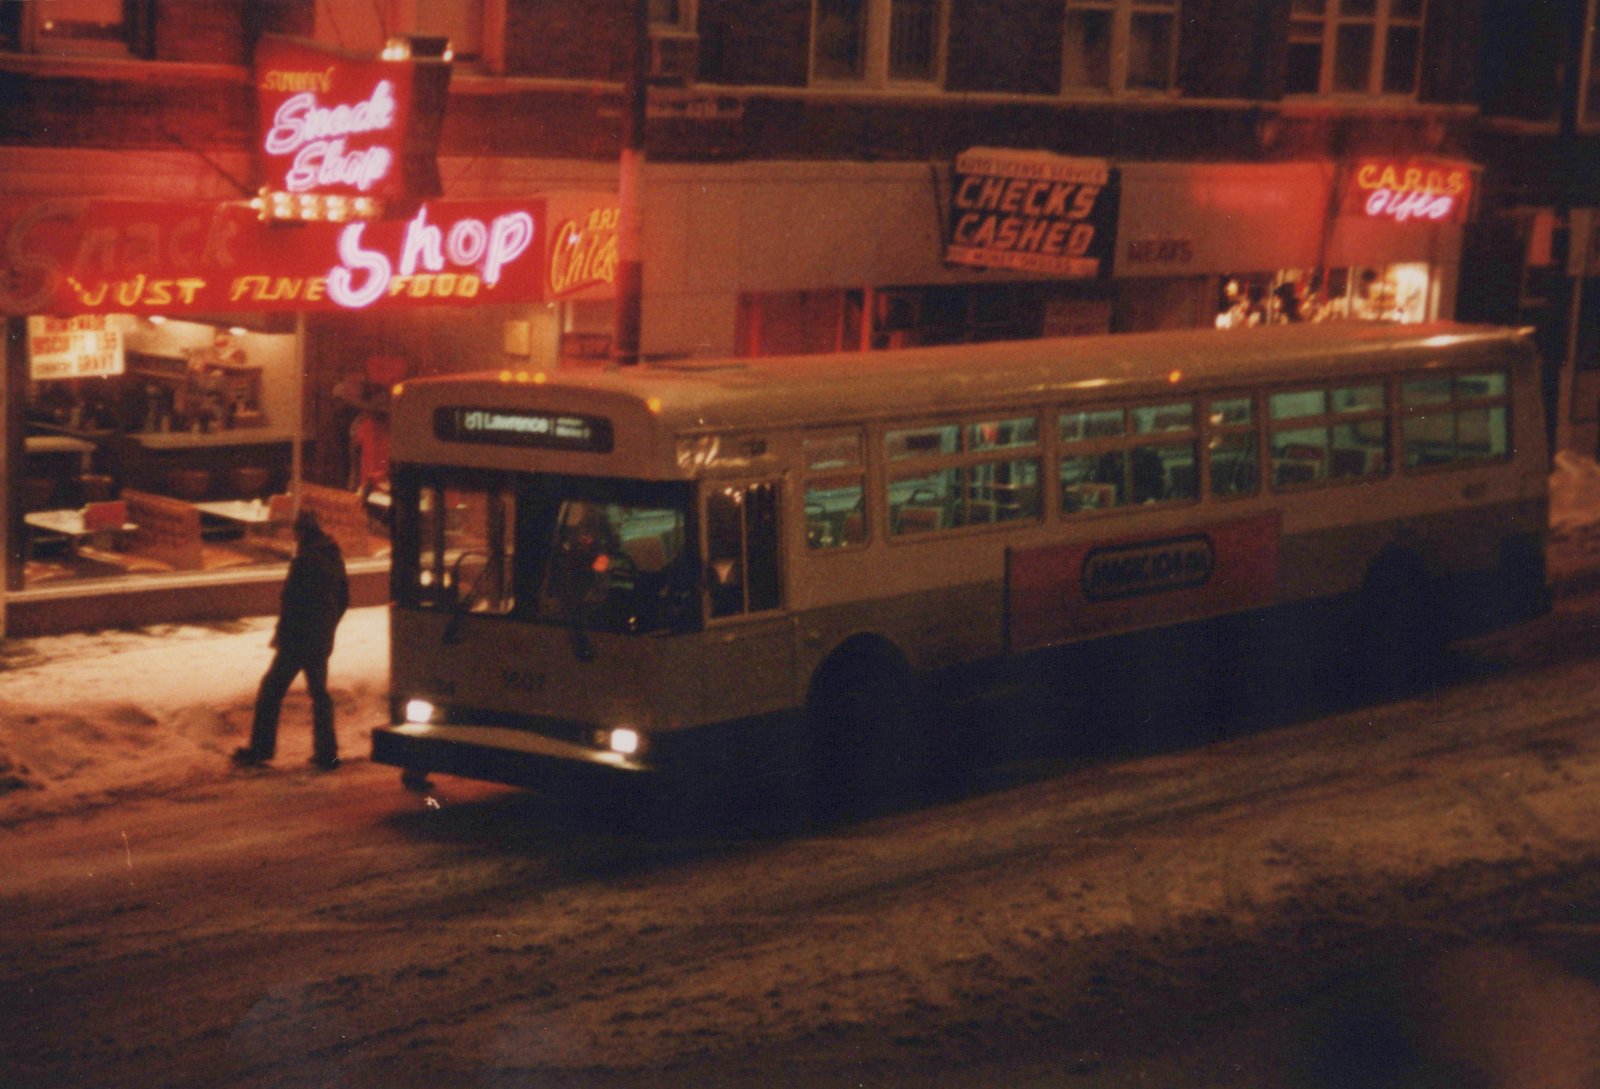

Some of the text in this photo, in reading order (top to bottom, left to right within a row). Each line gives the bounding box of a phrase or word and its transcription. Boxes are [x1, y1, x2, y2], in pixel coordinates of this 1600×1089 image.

[265, 79, 396, 155] Snack
[285, 139, 392, 192] Shop
[1357, 163, 1465, 195] CARDS
[955, 175, 1101, 219] CHECKS
[326, 205, 537, 309] Shop
[953, 211, 1097, 257] CASHED
[66, 273, 480, 307] JUST FINE FOOD
